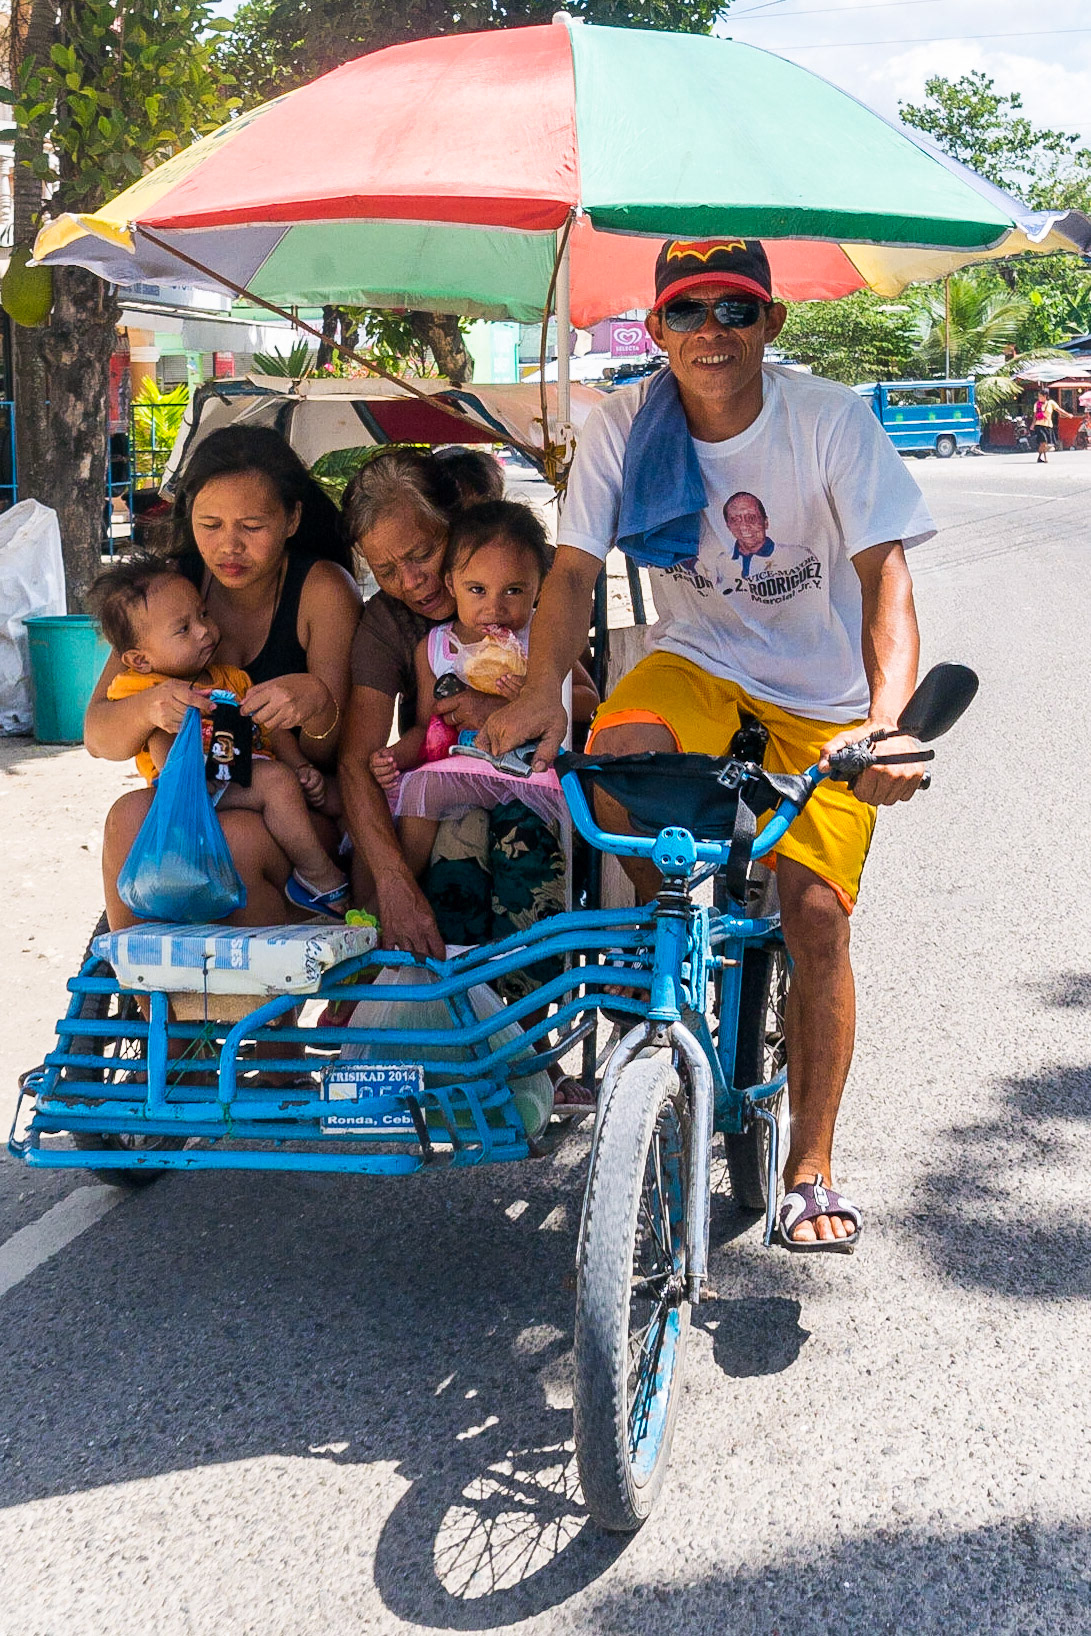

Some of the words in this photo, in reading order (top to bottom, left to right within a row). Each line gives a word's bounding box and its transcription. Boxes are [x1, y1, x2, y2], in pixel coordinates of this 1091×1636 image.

[735, 578, 748, 592] 2.
[748, 563, 822, 597] RODRIGUEZ
[751, 590, 796, 605] Marcial
[330, 1071, 386, 1082] TRISIKAD
[388, 1071, 416, 1082] 2014
[327, 1115, 378, 1126] Ronda,
